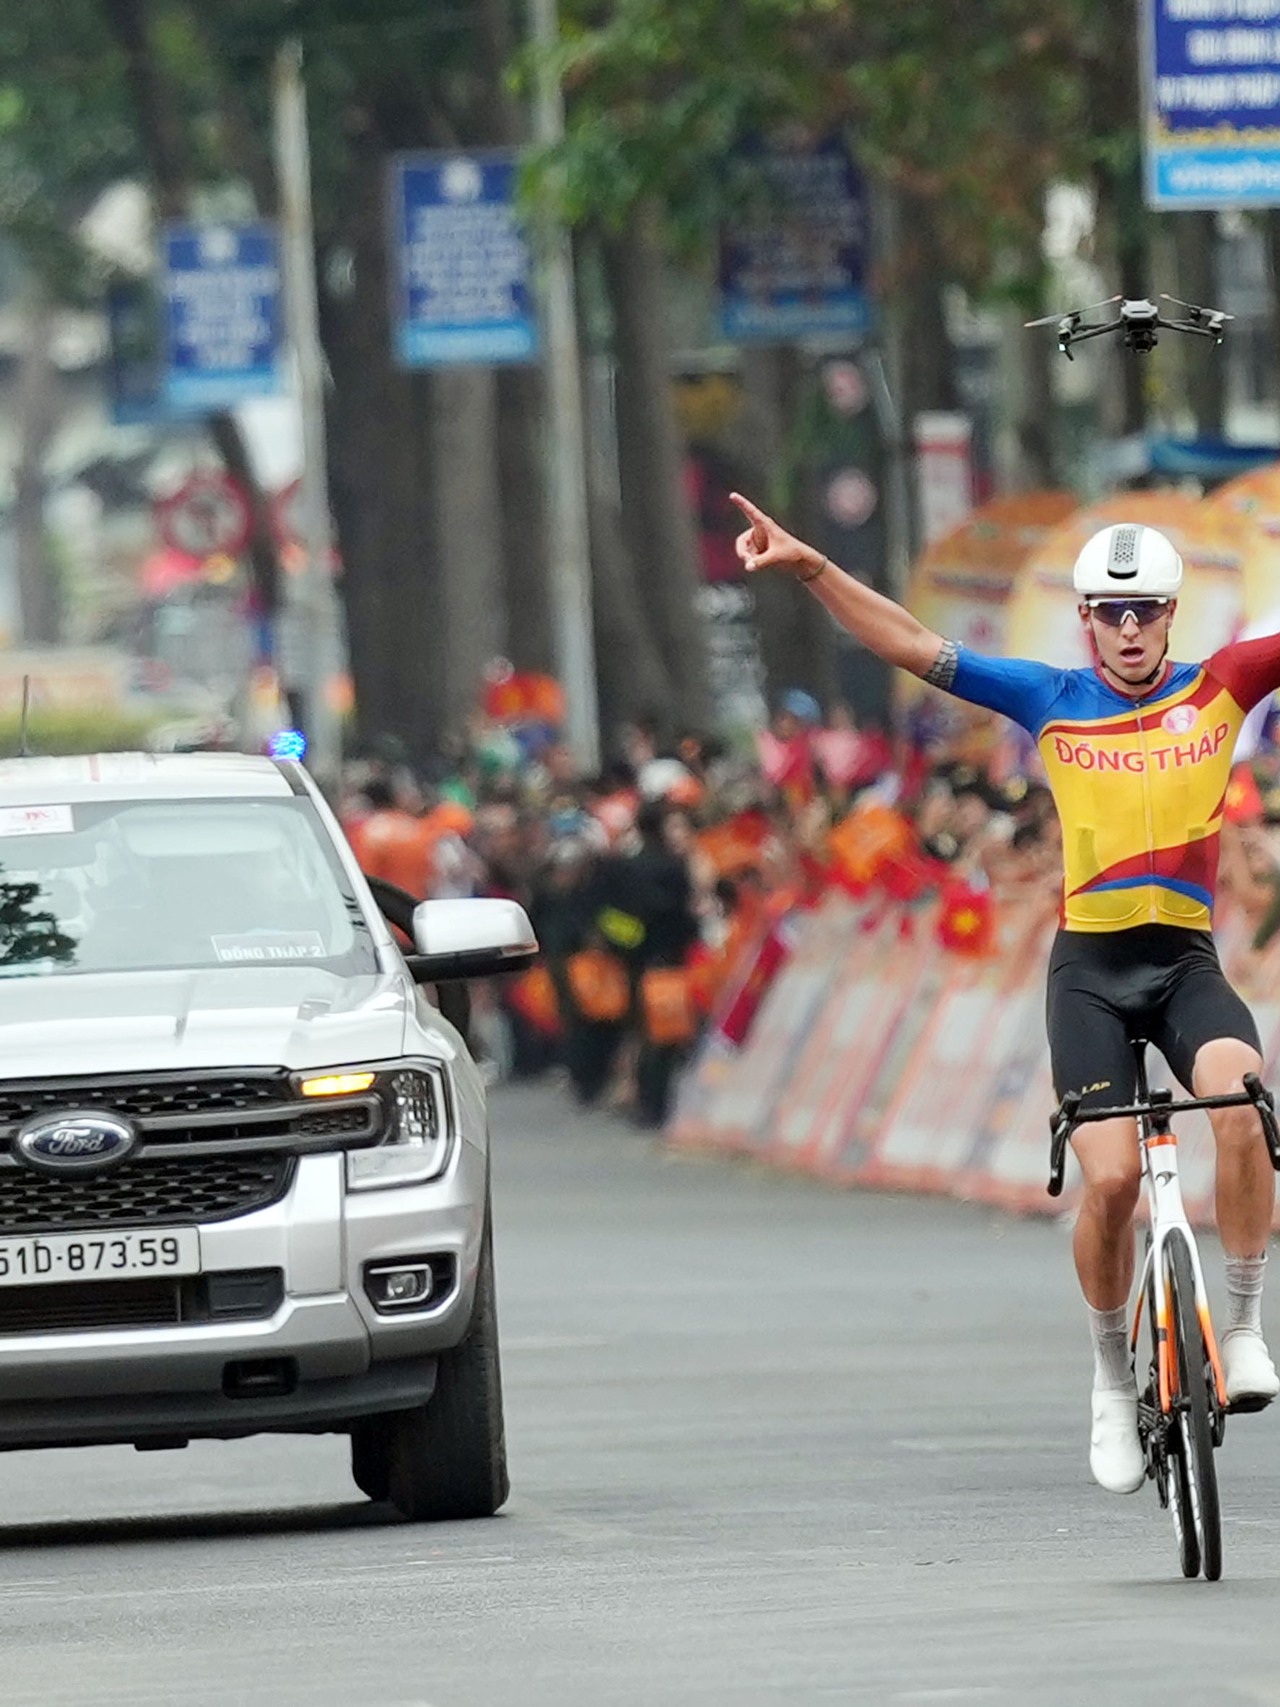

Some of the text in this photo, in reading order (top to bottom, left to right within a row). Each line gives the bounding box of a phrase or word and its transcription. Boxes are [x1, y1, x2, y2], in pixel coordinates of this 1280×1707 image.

[1054, 722, 1230, 773] ĐỒNG THÁP
[48, 1127, 105, 1153] Ford
